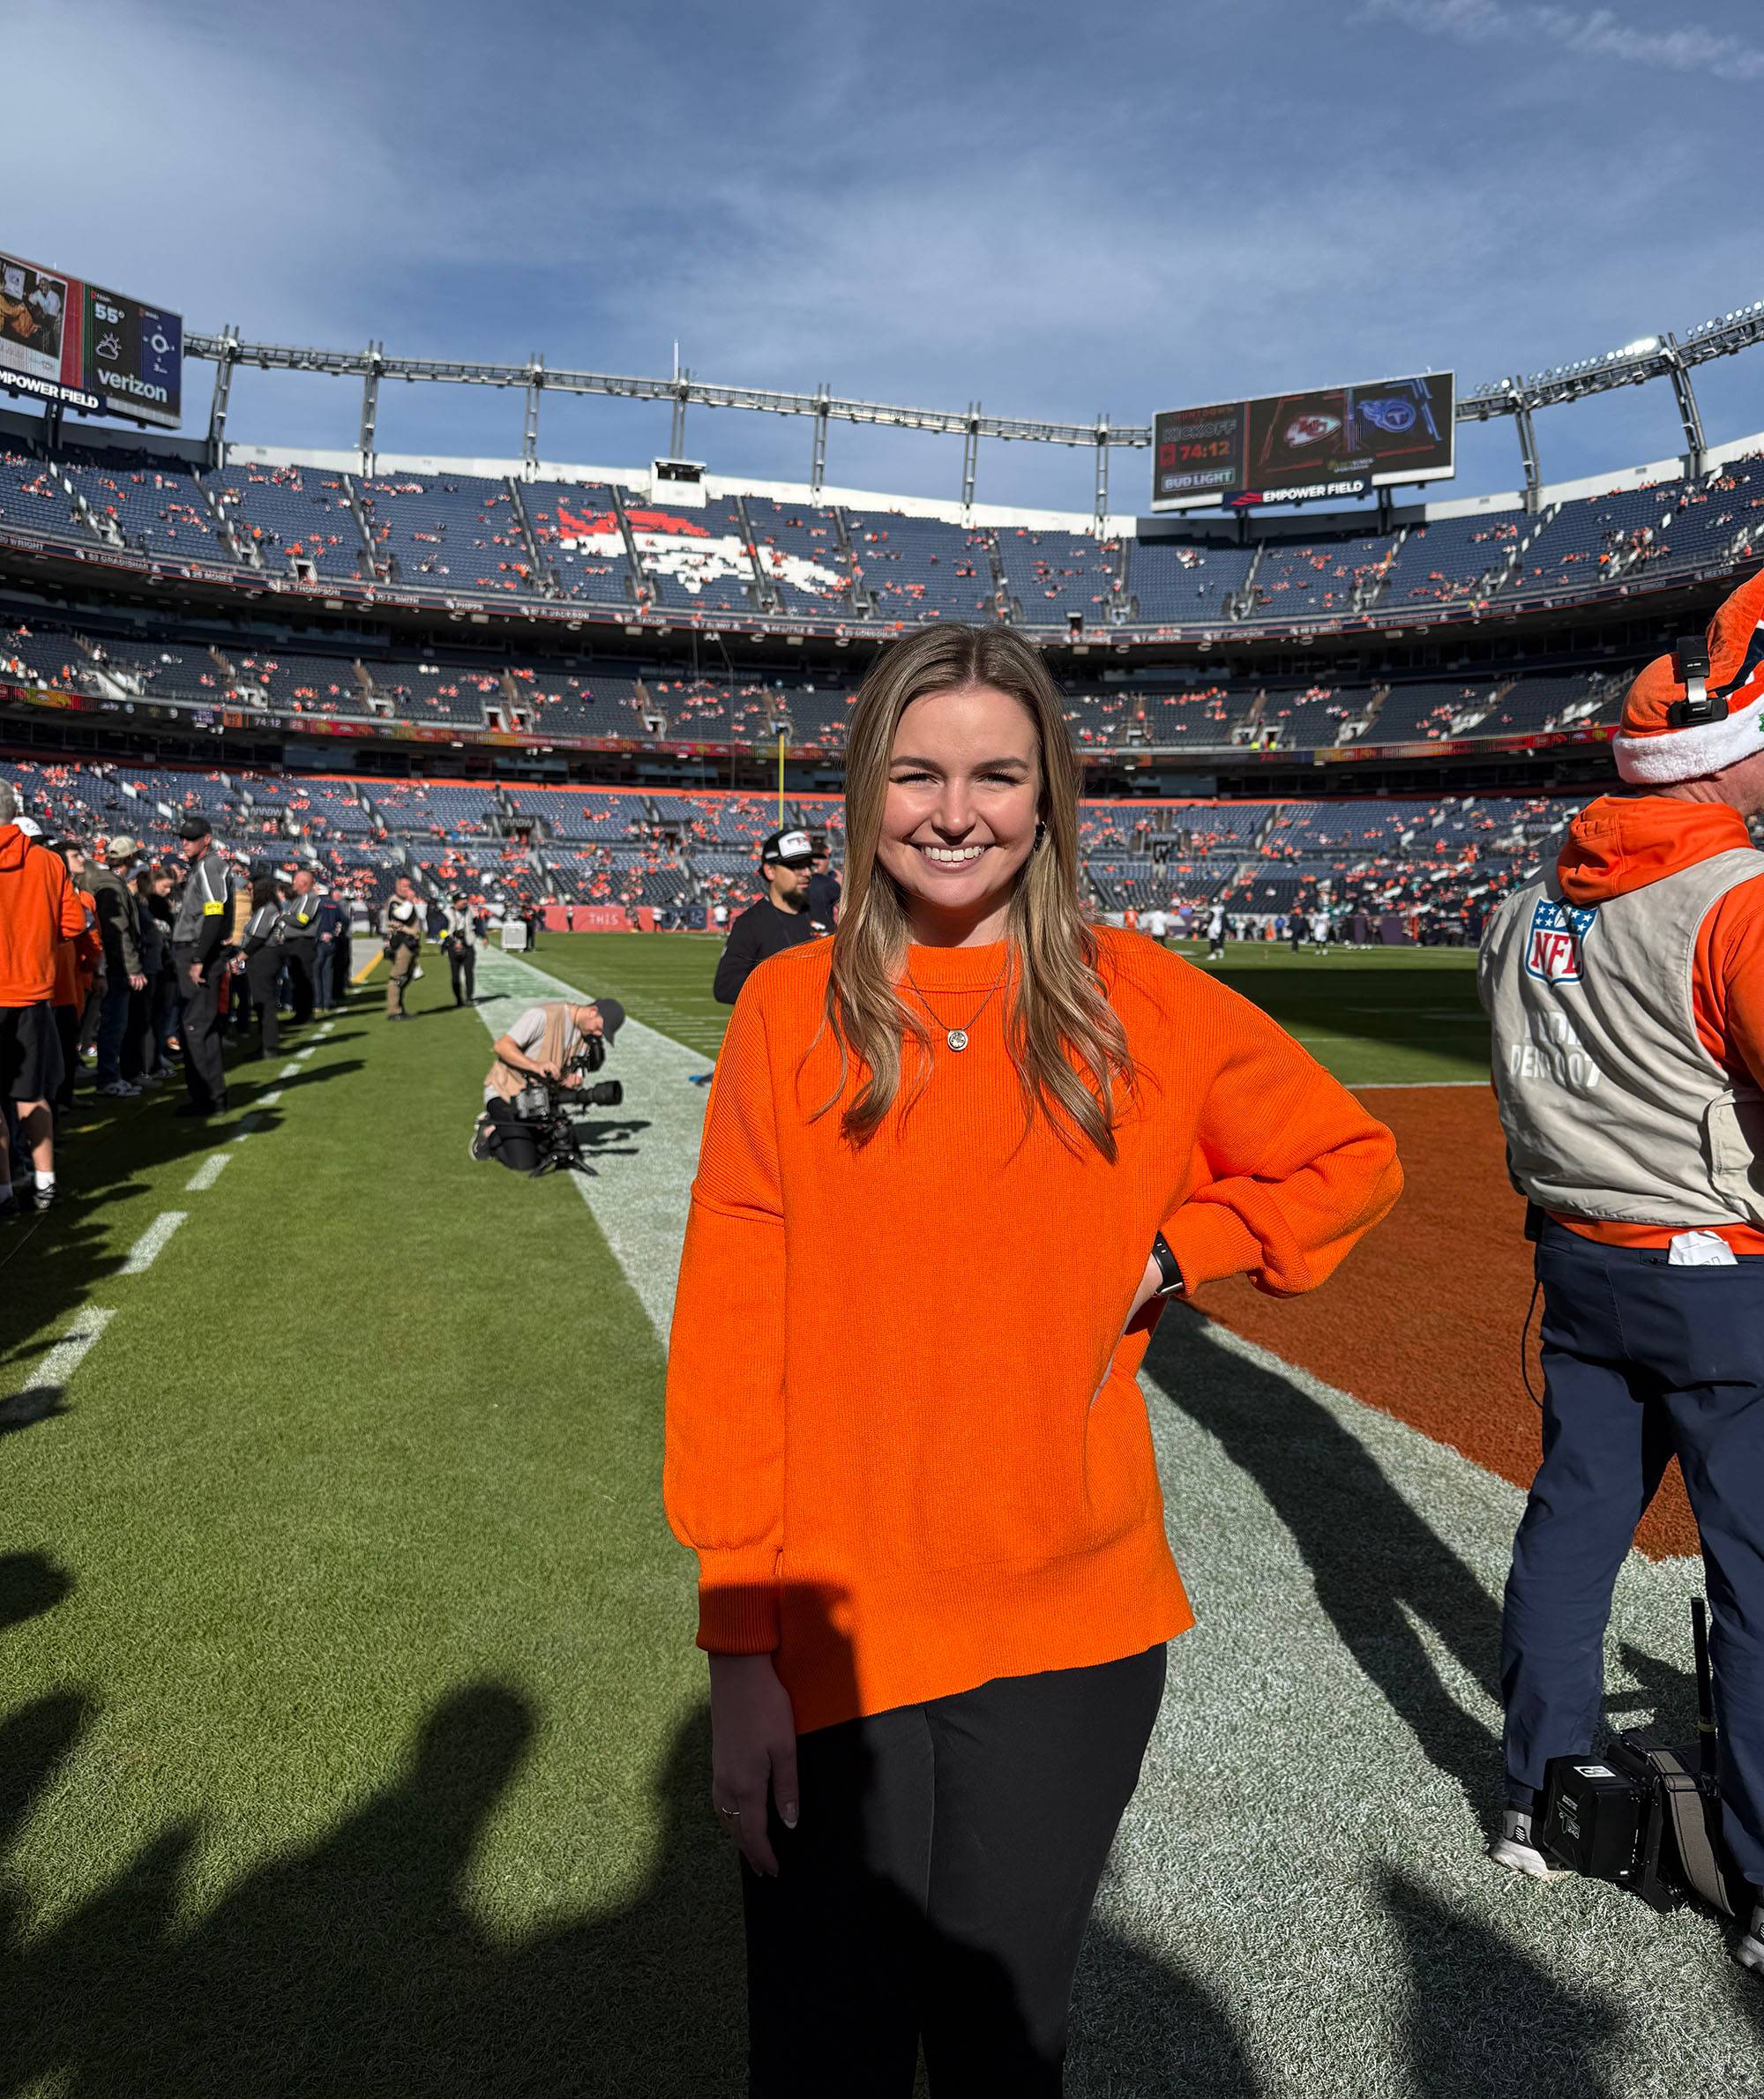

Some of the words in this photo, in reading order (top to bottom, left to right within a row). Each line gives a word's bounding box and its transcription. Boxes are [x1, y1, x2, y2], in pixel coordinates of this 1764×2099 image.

[97, 368, 168, 403] verizon
[60, 386, 99, 409] FIELD
[1163, 419, 1237, 441] KICKOFF
[1179, 441, 1230, 461] 74:12
[1165, 476, 1192, 489] BUD
[1192, 471, 1232, 486] LIGHT
[1262, 483, 1327, 503] EMPOWER
[1327, 480, 1365, 496] FIELD
[294, 585, 341, 597] THOMPSON
[254, 716, 281, 728] 74:12
[587, 911, 618, 926] THIS
[1530, 930, 1582, 978] NFL
